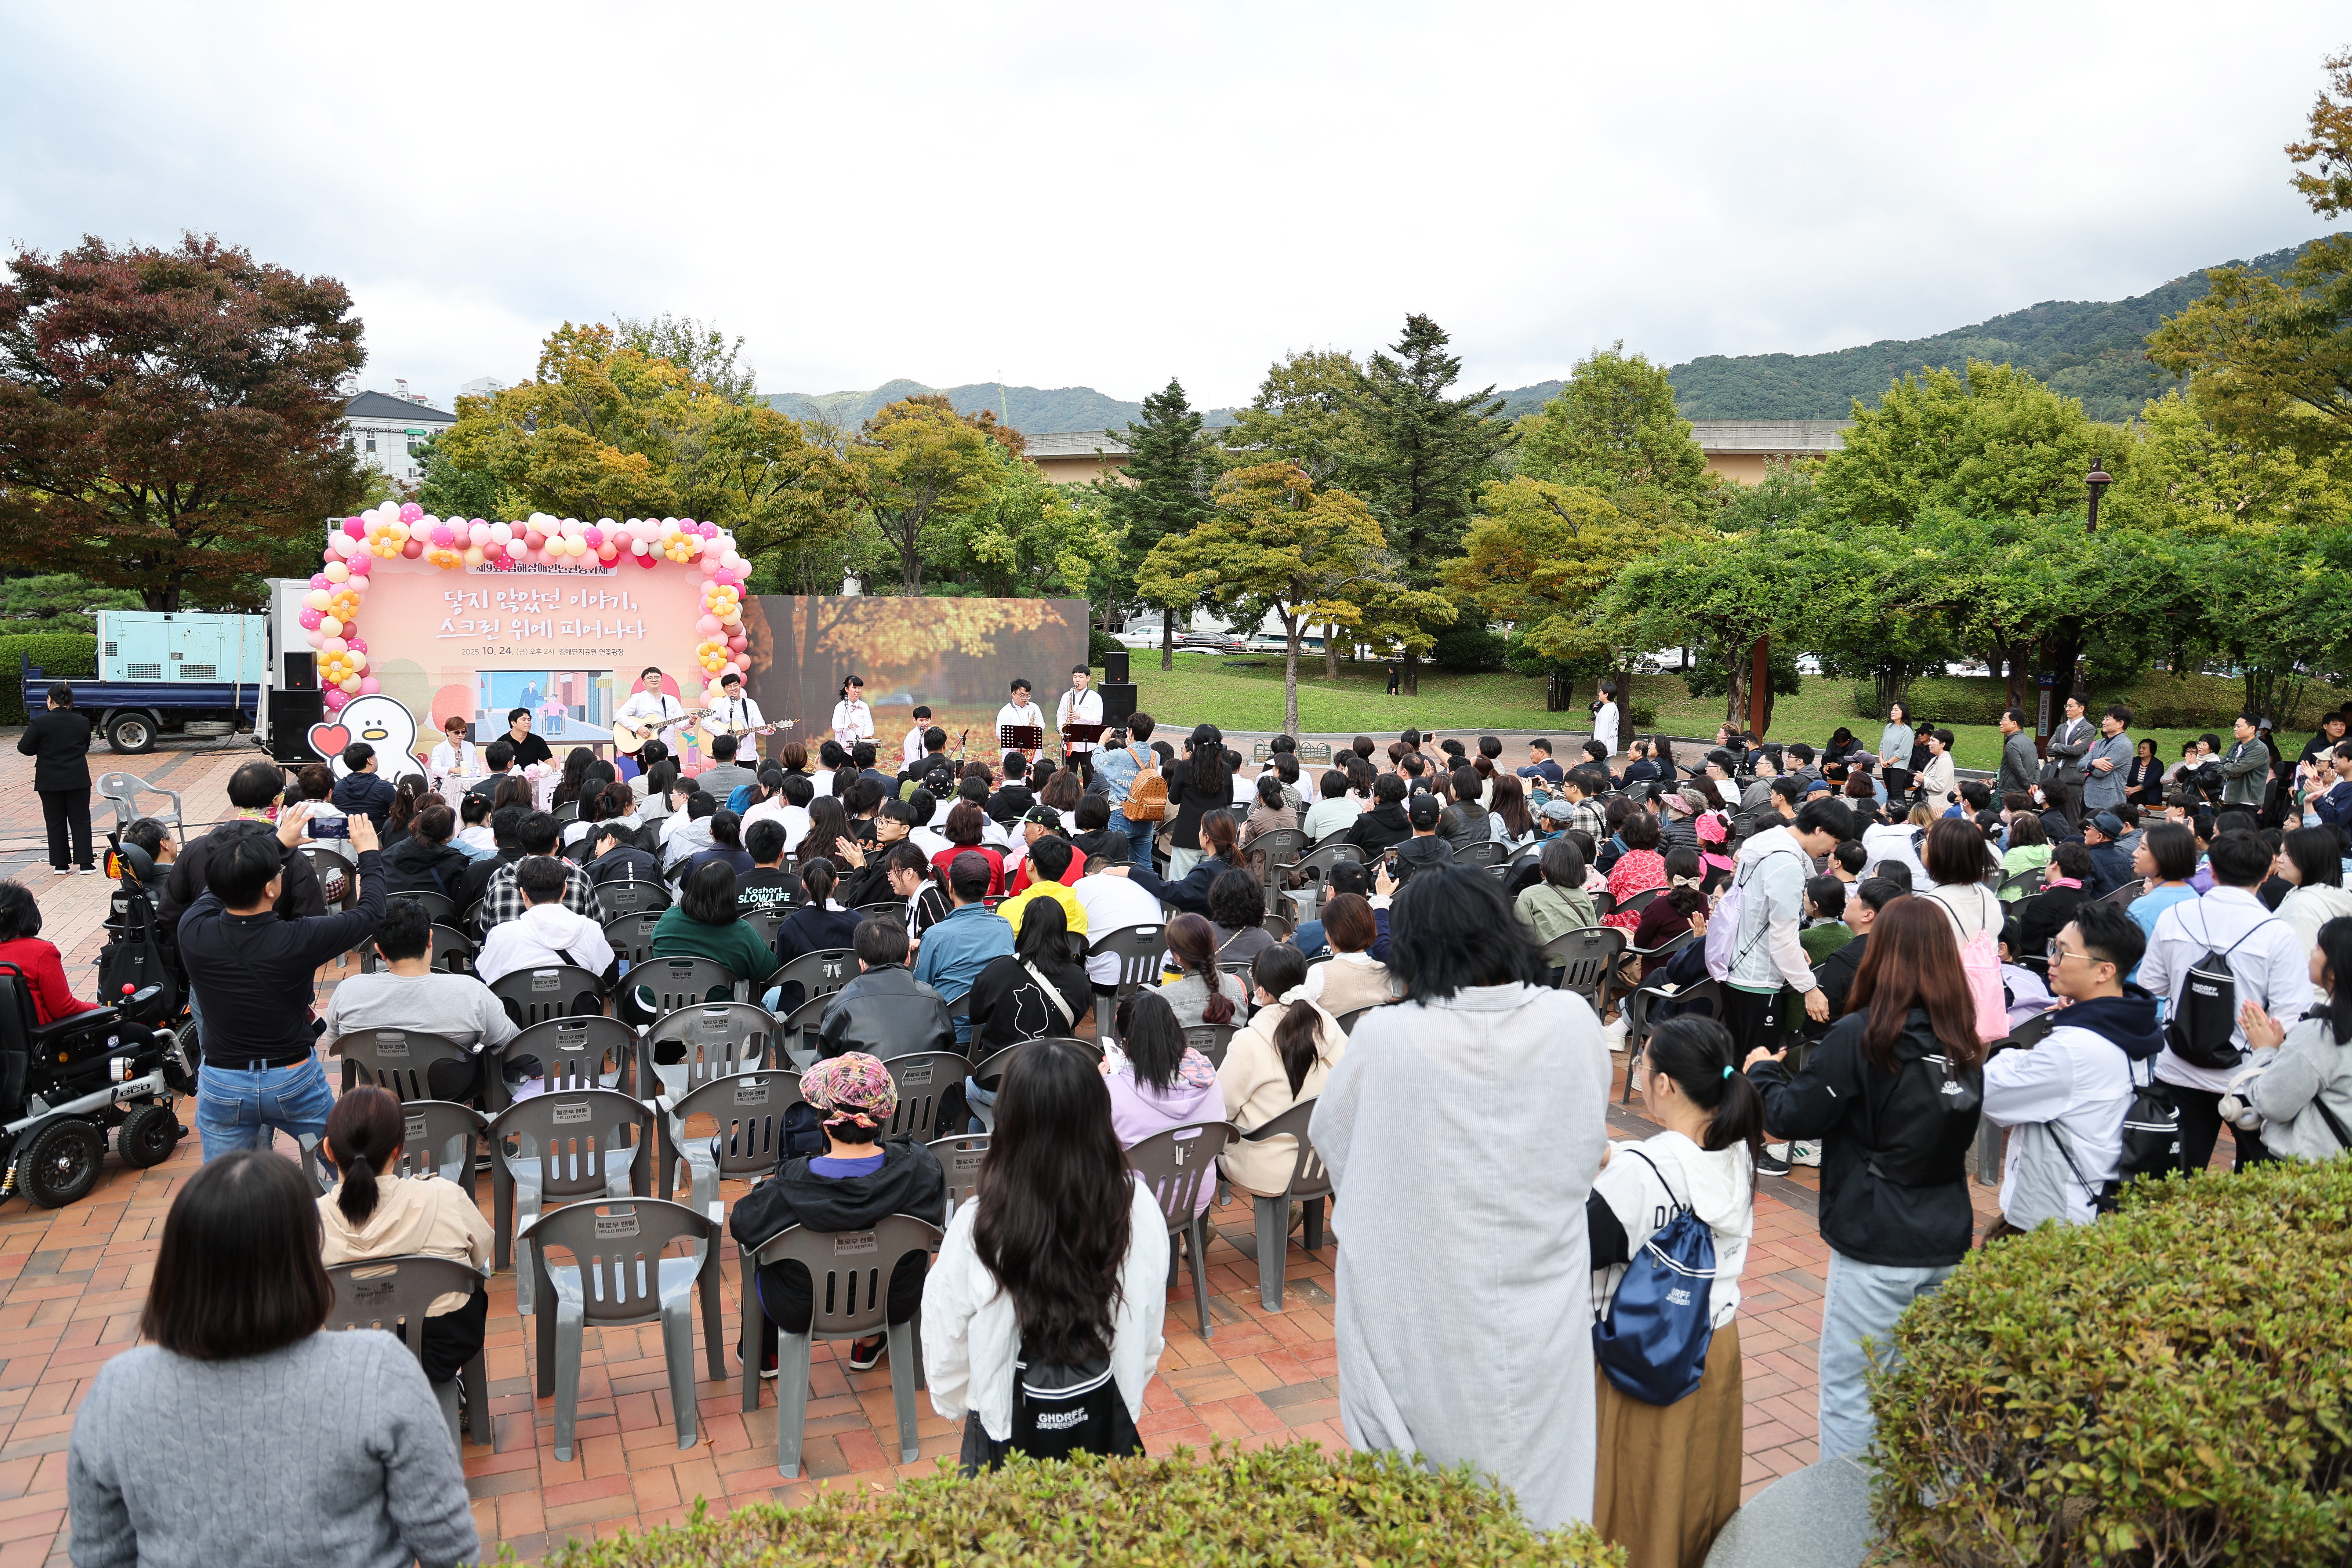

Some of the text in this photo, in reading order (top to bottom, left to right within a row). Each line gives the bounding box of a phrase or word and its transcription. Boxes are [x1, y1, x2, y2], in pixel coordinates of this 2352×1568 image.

[444, 587, 638, 615] 닿지 않았던 이야기,
[436, 617, 648, 641] 스크린 위에 피어나다
[482, 647, 496, 655] 10.
[499, 647, 514, 655] 24.
[1116, 779, 1134, 789] PIN
[738, 893, 791, 904] SLOW LIFE
[120, 1083, 151, 1097] eco
[1038, 1406, 1085, 1423] GHDRFF
